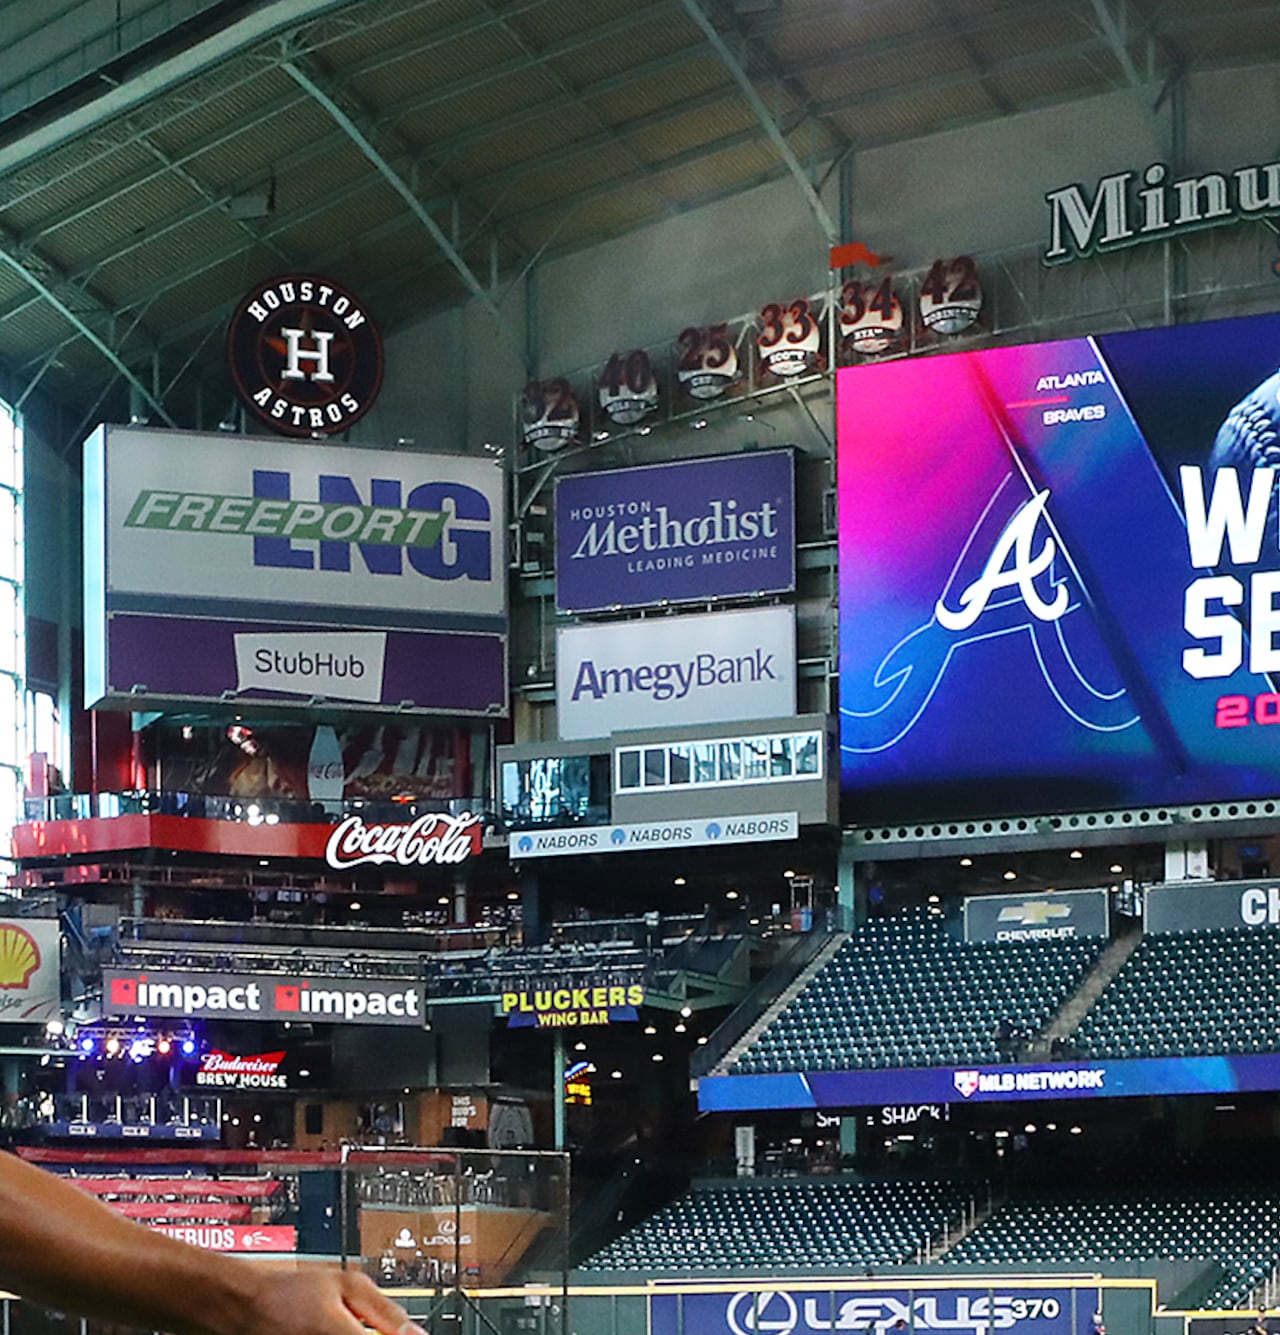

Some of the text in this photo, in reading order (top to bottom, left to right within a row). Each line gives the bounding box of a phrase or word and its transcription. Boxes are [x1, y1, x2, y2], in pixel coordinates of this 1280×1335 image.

[922, 256, 982, 305] 42
[247, 281, 366, 330] HOUSTON
[840, 276, 899, 326] 34
[757, 299, 813, 348] 33
[281, 327, 335, 382] H
[677, 324, 732, 371] 25
[599, 350, 653, 397] 40
[1036, 370, 1106, 391] ATLANTA
[253, 387, 359, 427] ASTROS
[1043, 405, 1106, 425] BRAVES
[134, 493, 440, 544] FREEPORT
[253, 470, 491, 581] LNG
[571, 501, 652, 520] HOUSTON
[571, 500, 778, 559] Methodist
[627, 546, 778, 573] LEADING MEDICINE
[935, 488, 1069, 631] A
[254, 649, 365, 678] StubHub
[571, 648, 775, 701] AmegyBank
[537, 819, 790, 849] NABORS NABORS NABORS
[996, 926, 1076, 942] CHEVROLET
[137, 975, 419, 1020] impact impact
[502, 985, 645, 1013] PLUCKERS
[537, 1010, 609, 1027] WING BAR
[197, 1072, 288, 1088] BREW HOUSE
[201, 1053, 278, 1073] Budweiser
[979, 1070, 1106, 1092] MLB NETWORK
[423, 1235, 472, 1246] LEXUS
[1011, 1299, 1060, 1320] 370
